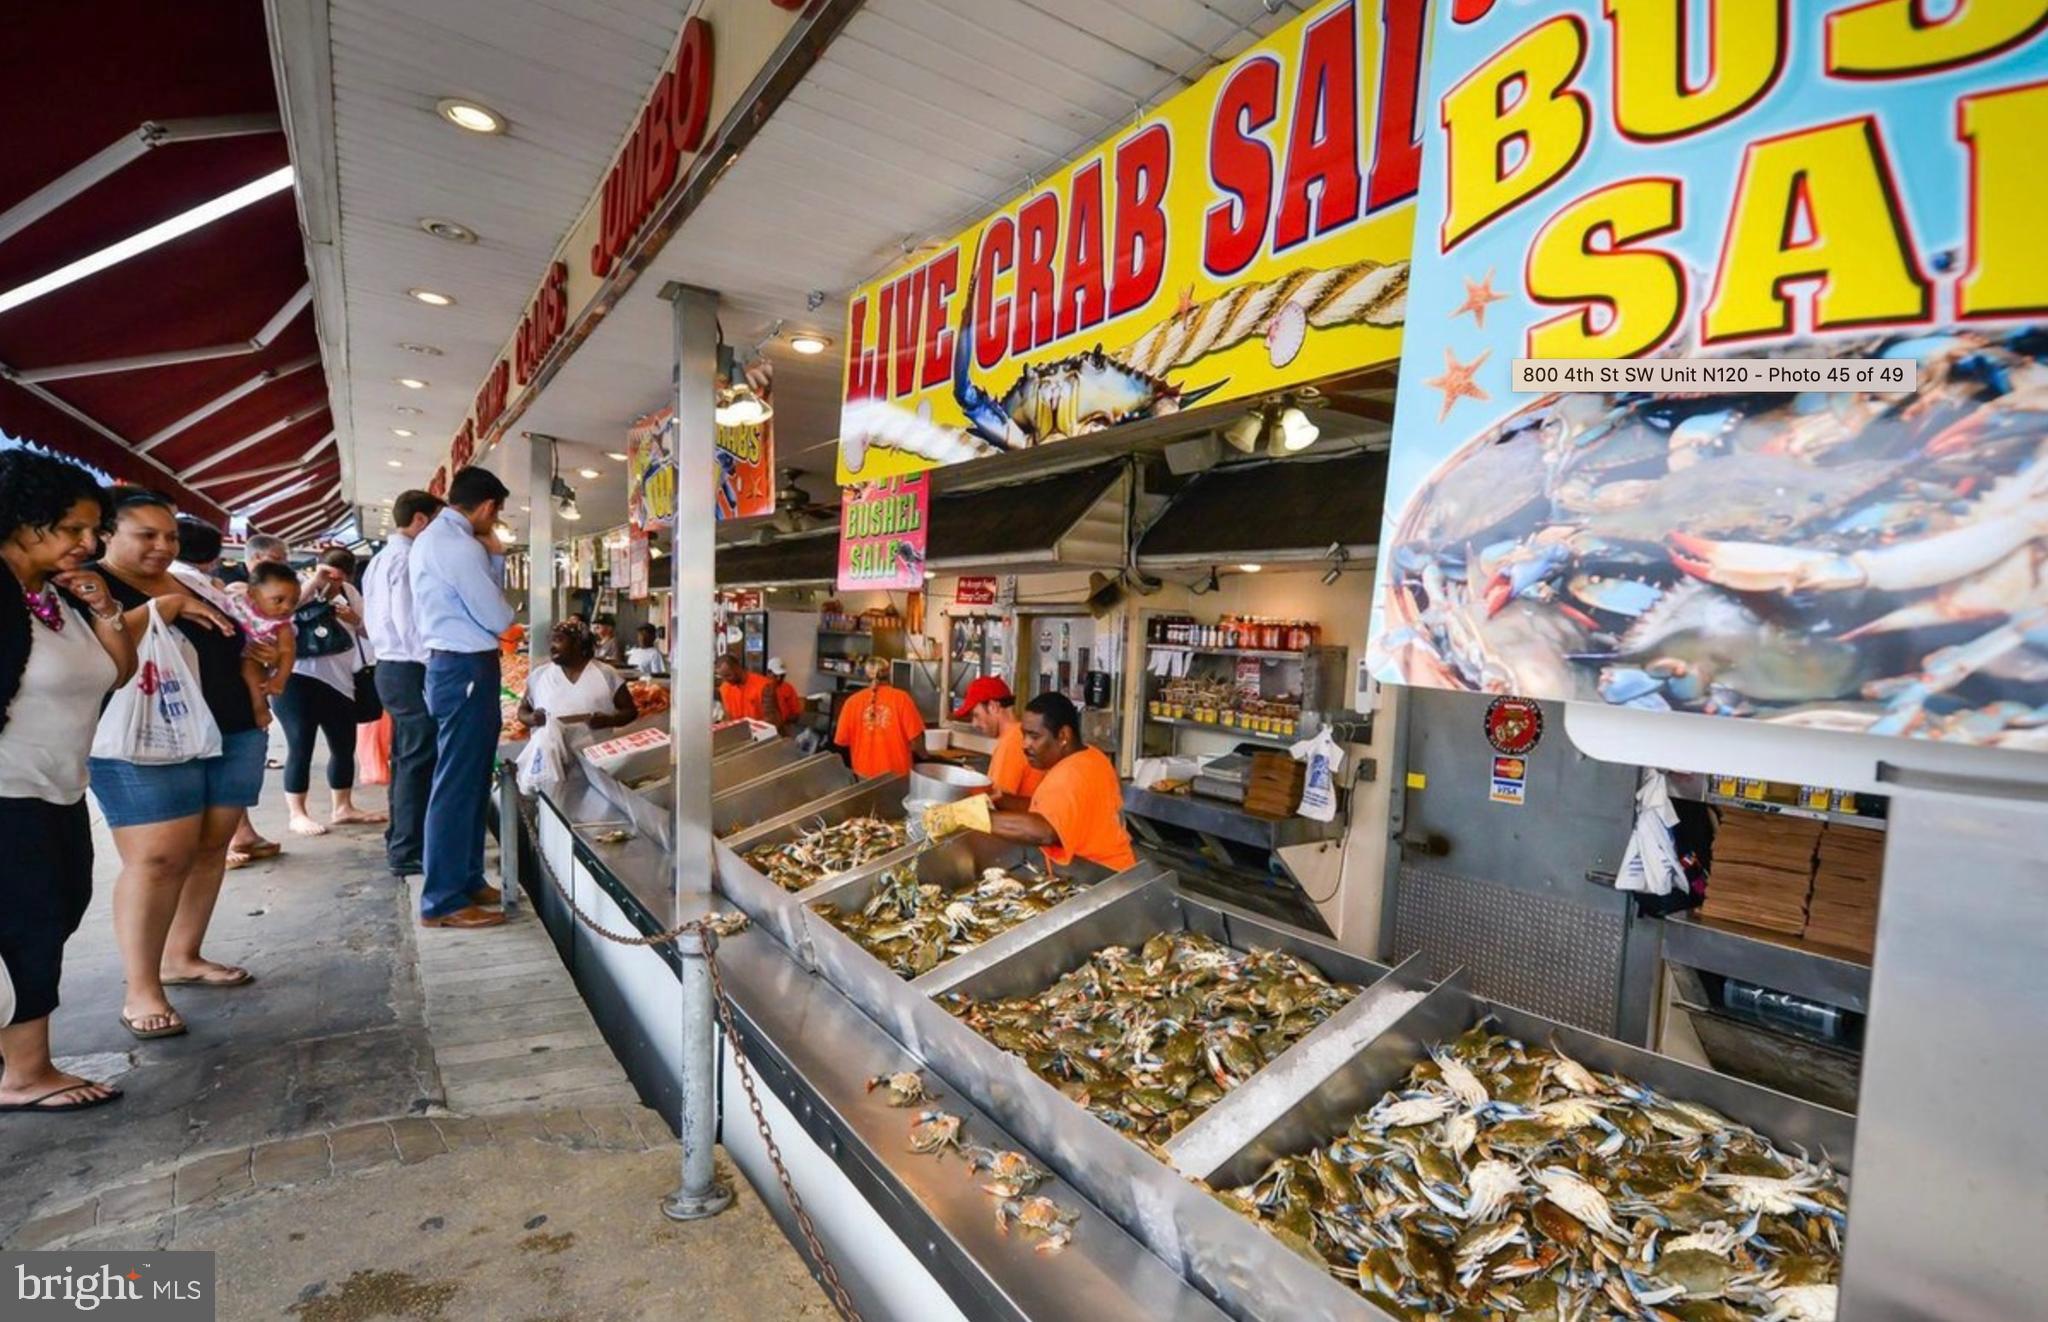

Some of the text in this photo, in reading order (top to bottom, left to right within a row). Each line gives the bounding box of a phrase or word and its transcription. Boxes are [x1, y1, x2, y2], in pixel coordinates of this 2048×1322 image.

[591, 16, 716, 278] JUMBO
[846, 0, 1426, 405] LIVE CRAB SAL
[846, 493, 920, 539] BUSHEL
[849, 540, 900, 579] SALE
